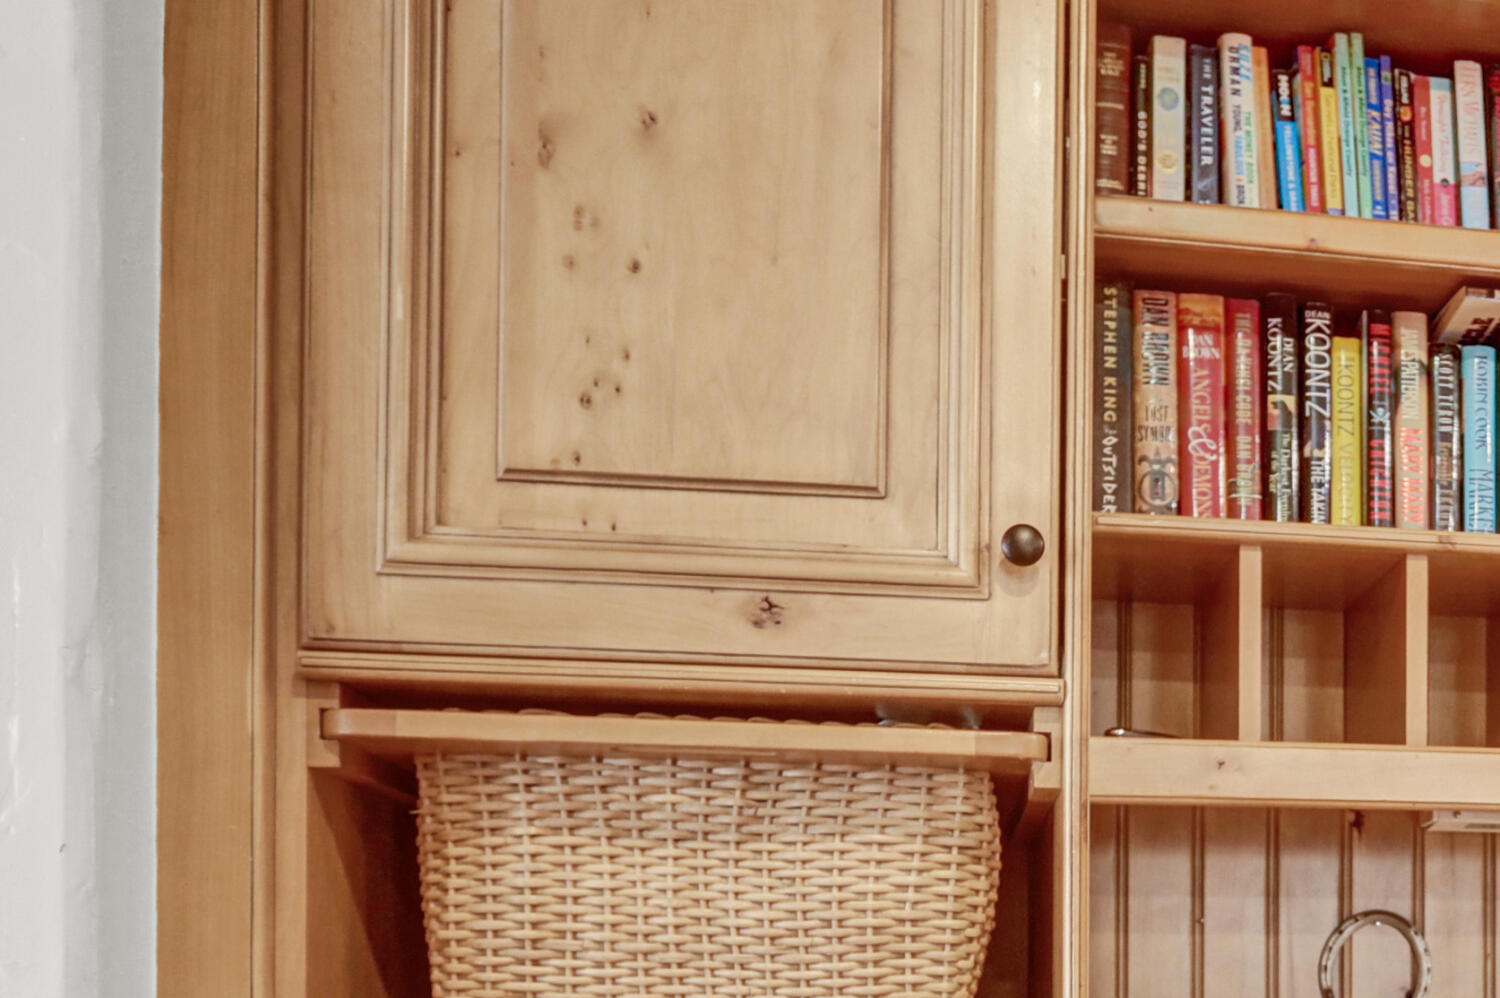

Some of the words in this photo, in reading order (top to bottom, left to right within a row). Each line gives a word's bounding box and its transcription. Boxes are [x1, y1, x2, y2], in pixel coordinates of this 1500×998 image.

[1202, 59, 1211, 79] THE
[1228, 48, 1241, 97] ORMAN
[1200, 85, 1213, 166] TRAVELER
[1367, 109, 1383, 158] KAUAI
[1102, 287, 1118, 369] STEPHEN
[1141, 297, 1170, 327] DAN
[1304, 310, 1330, 318] DEAN
[1140, 331, 1171, 387] BROWN
[1267, 318, 1283, 392] KOONTZ
[1282, 338, 1294, 373] DEAN
[1304, 319, 1331, 418] KOONTZ
[1369, 324, 1391, 394] MICHAEL
[1400, 328, 1419, 362] JAMES
[1102, 376, 1118, 423] KING
[1191, 368, 1213, 432] ANGELS
[1336, 365, 1355, 438] KOONTZ
[1400, 362, 1419, 421] PATTERSON
[1475, 356, 1489, 403] ROBIN
[1235, 394, 1251, 425] CODE
[1475, 408, 1489, 451] COOK
[1188, 426, 1218, 462] &
[1235, 436, 1251, 461] DAN
[1399, 427, 1424, 475] MARY
[1192, 455, 1212, 519] DEMONS
[1310, 460, 1326, 482] THE
[1400, 478, 1424, 526] MARY
